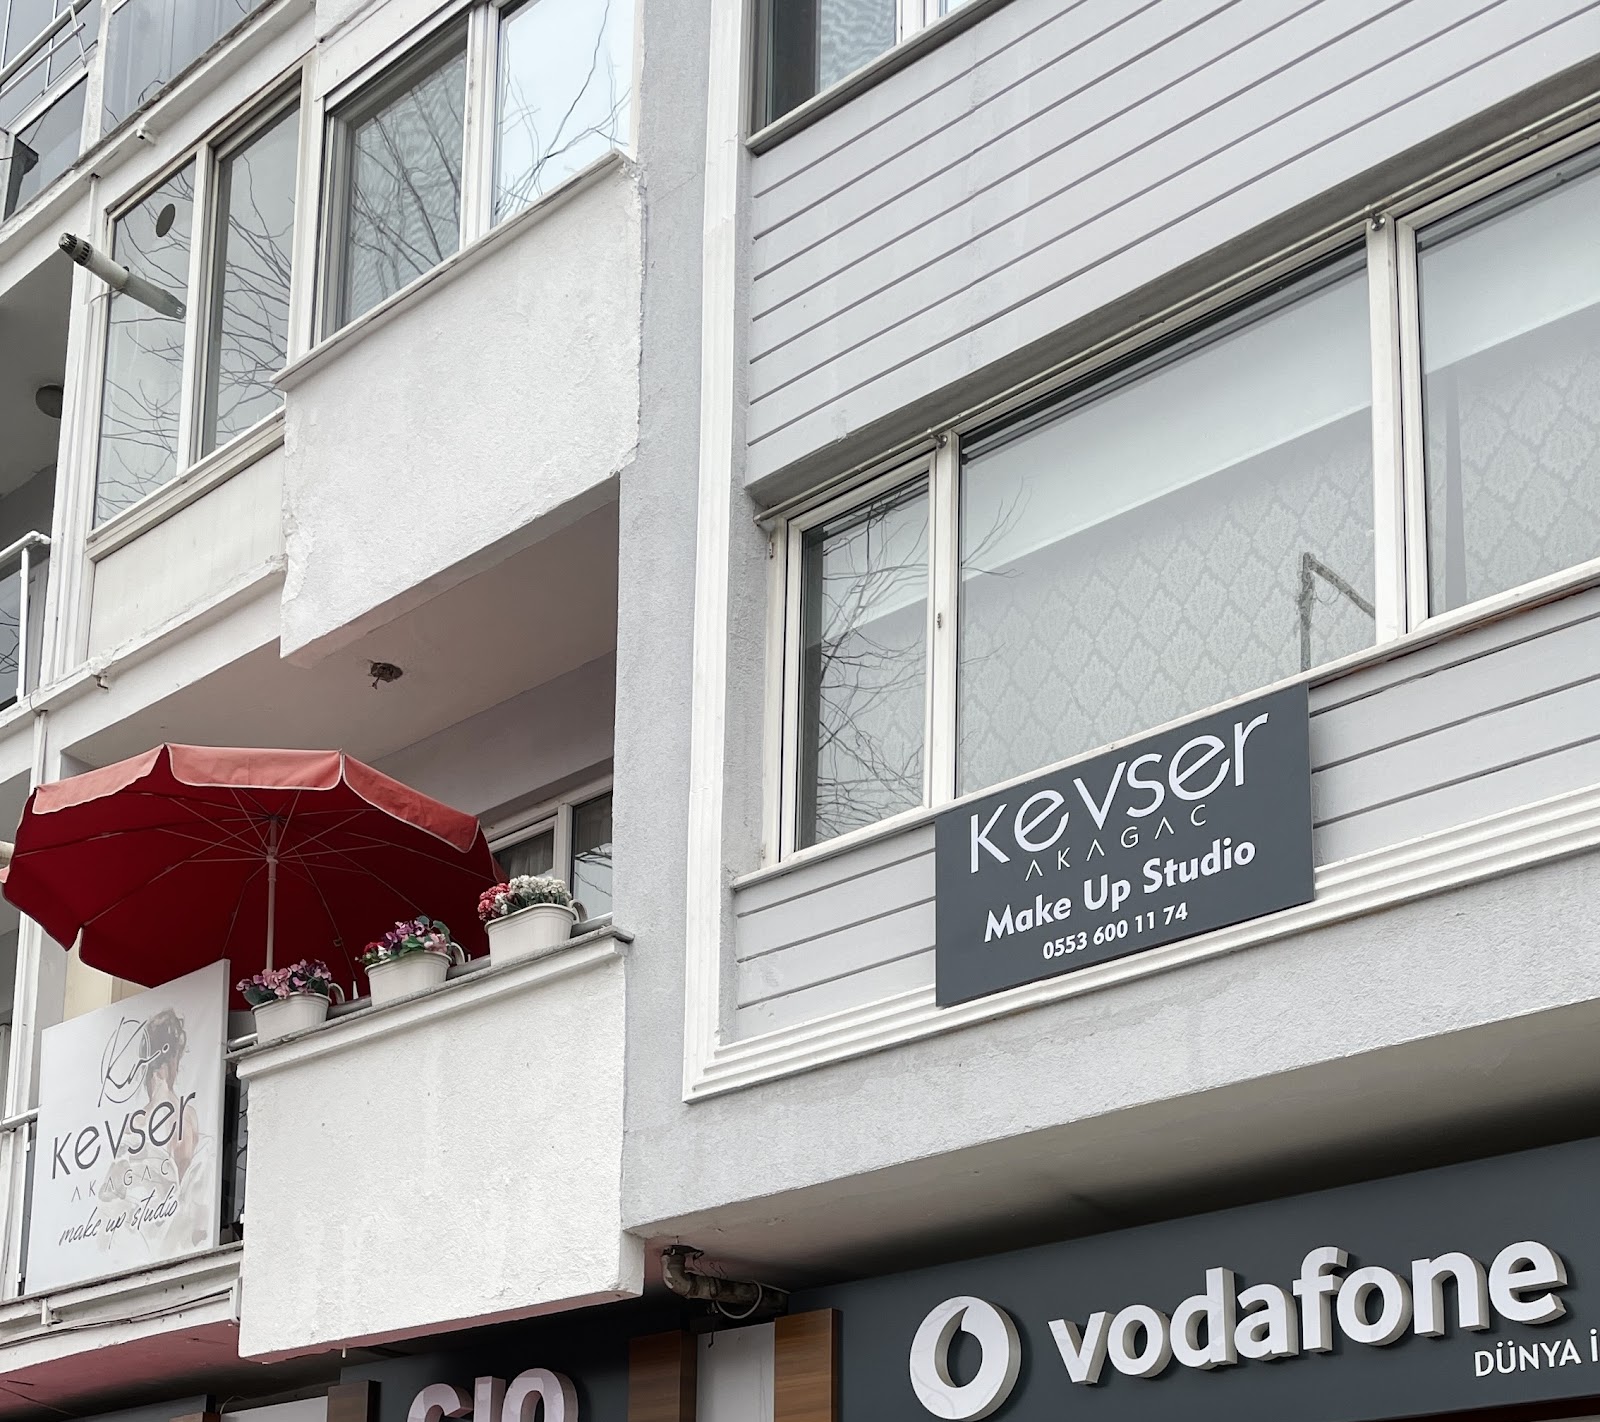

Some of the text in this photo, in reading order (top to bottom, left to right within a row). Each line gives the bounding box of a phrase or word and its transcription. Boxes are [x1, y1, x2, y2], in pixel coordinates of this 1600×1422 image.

[984, 836, 1257, 943] Make Up Studio
[1042, 902, 1188, 960] 0553 600 11 74
[59, 1185, 178, 1250] make up studio
[1048, 1240, 1568, 1385] vodafone
[1474, 1338, 1582, 1377] DÜNYA
